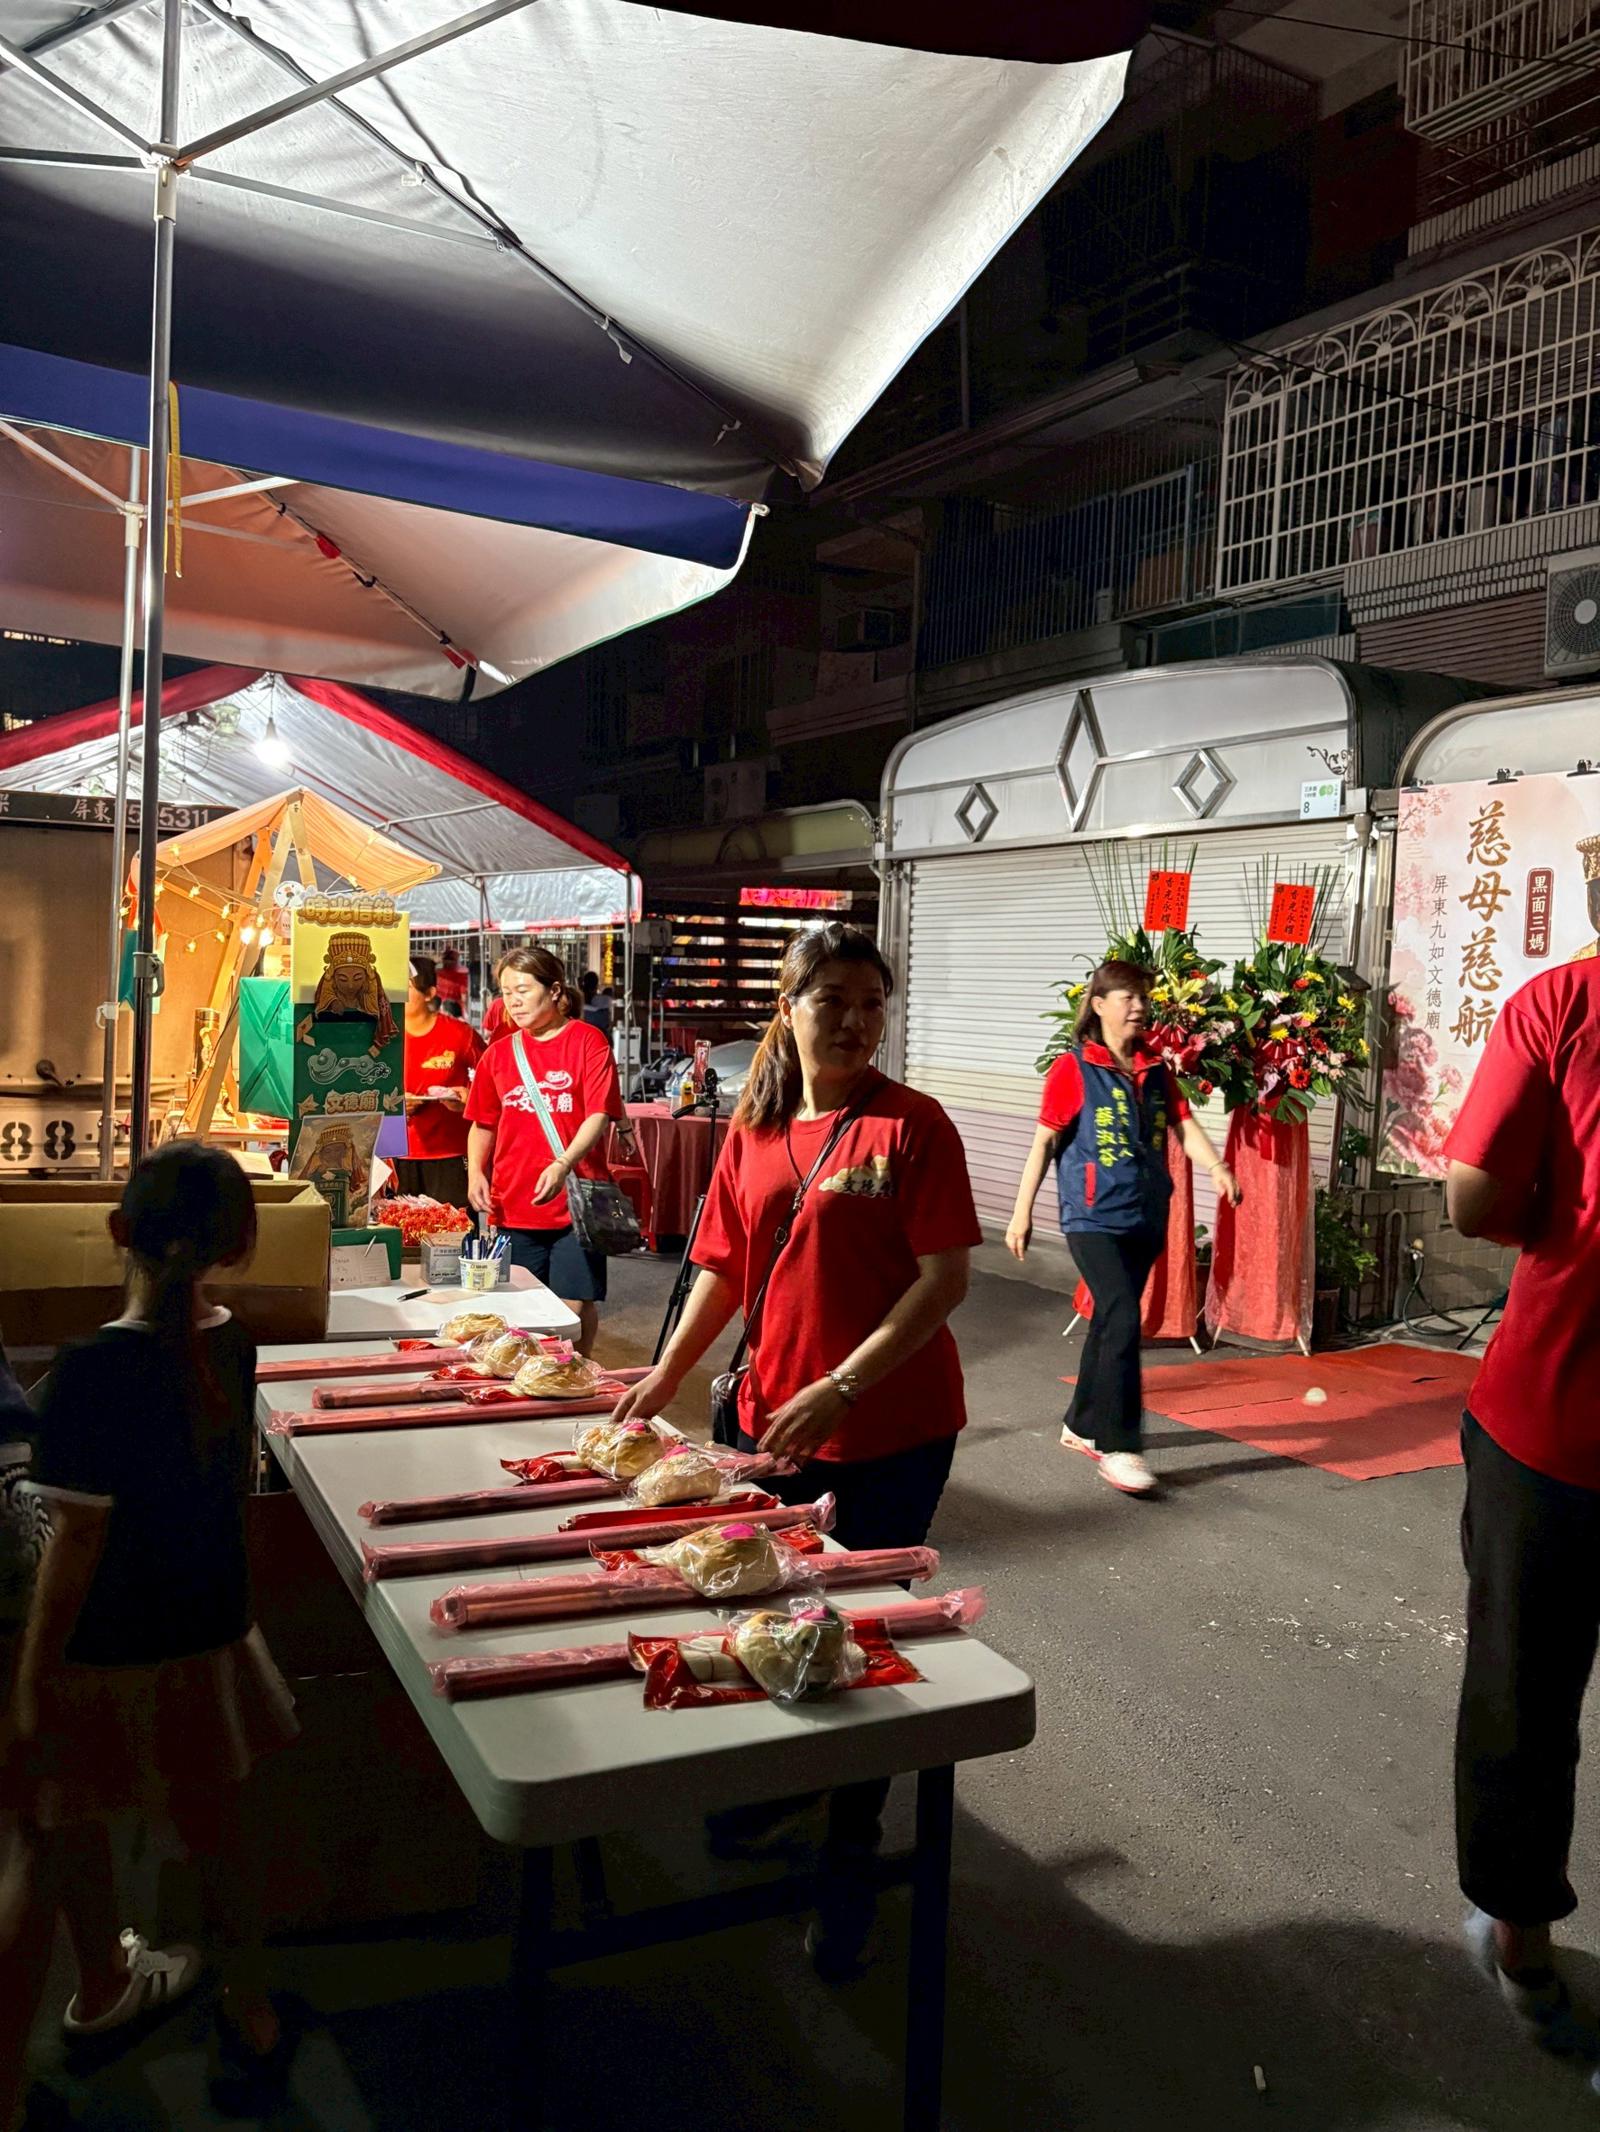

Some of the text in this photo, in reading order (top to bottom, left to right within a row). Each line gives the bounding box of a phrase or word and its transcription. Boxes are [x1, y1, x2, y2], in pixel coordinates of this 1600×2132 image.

[70, 798, 209, 828] 屏東 55311
[1303, 801, 1310, 814] 8
[304, 896, 395, 923] 時光信箱
[1449, 800, 1511, 1048] 慈母慈航
[1528, 875, 1549, 952] 黑面三媽
[1424, 874, 1449, 1030] 屏東九如文德廟
[326, 1091, 378, 1113] 文德廟
